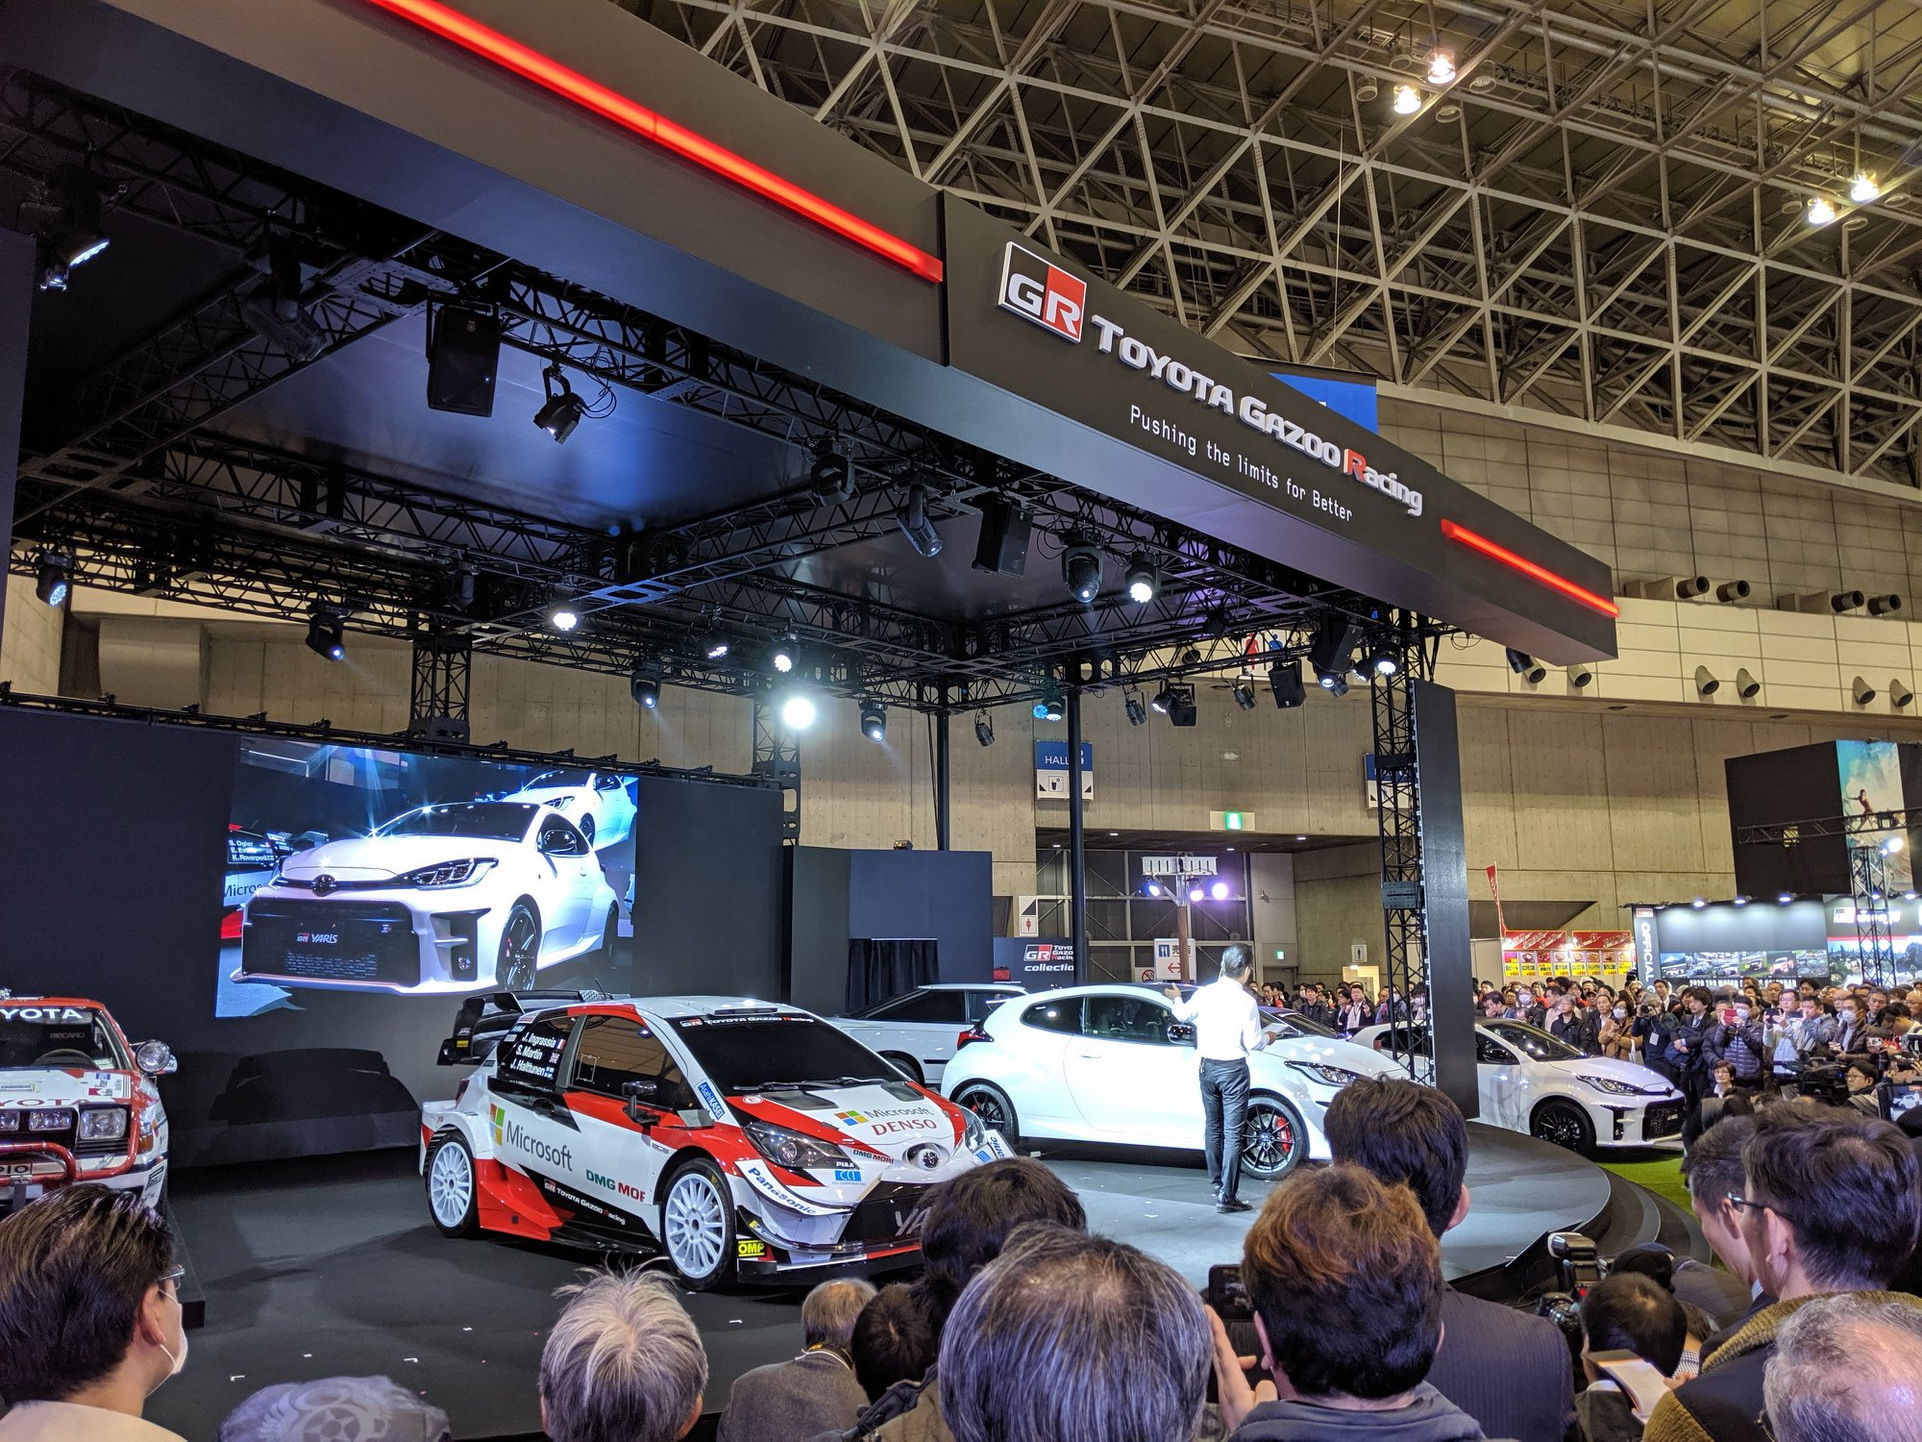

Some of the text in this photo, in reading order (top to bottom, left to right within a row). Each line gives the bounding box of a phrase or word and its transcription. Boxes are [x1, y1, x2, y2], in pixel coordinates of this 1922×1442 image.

[1007, 272, 1423, 517] GR TOYOTA GAZOO Racing
[1130, 404, 1354, 523] Pushing the limits for Better
[1045, 756, 1069, 765] HALL
[1641, 922, 1655, 982] OFFICIAL
[704, 1017, 747, 1025] TOYOTA
[528, 1033, 557, 1048] Ingrassia
[522, 1046, 543, 1061] Martin
[864, 1106, 934, 1119] Microsoft
[871, 1119, 937, 1136] DENSO
[506, 1121, 573, 1172] Microsoft
[853, 1150, 895, 1165] DMG MORI
[586, 1169, 616, 1191] DMG
[748, 1167, 817, 1214] Panasonic
[556, 1187, 580, 1204] TOYOTA
[603, 1209, 626, 1226] Racing
[738, 1242, 765, 1254] OMP
